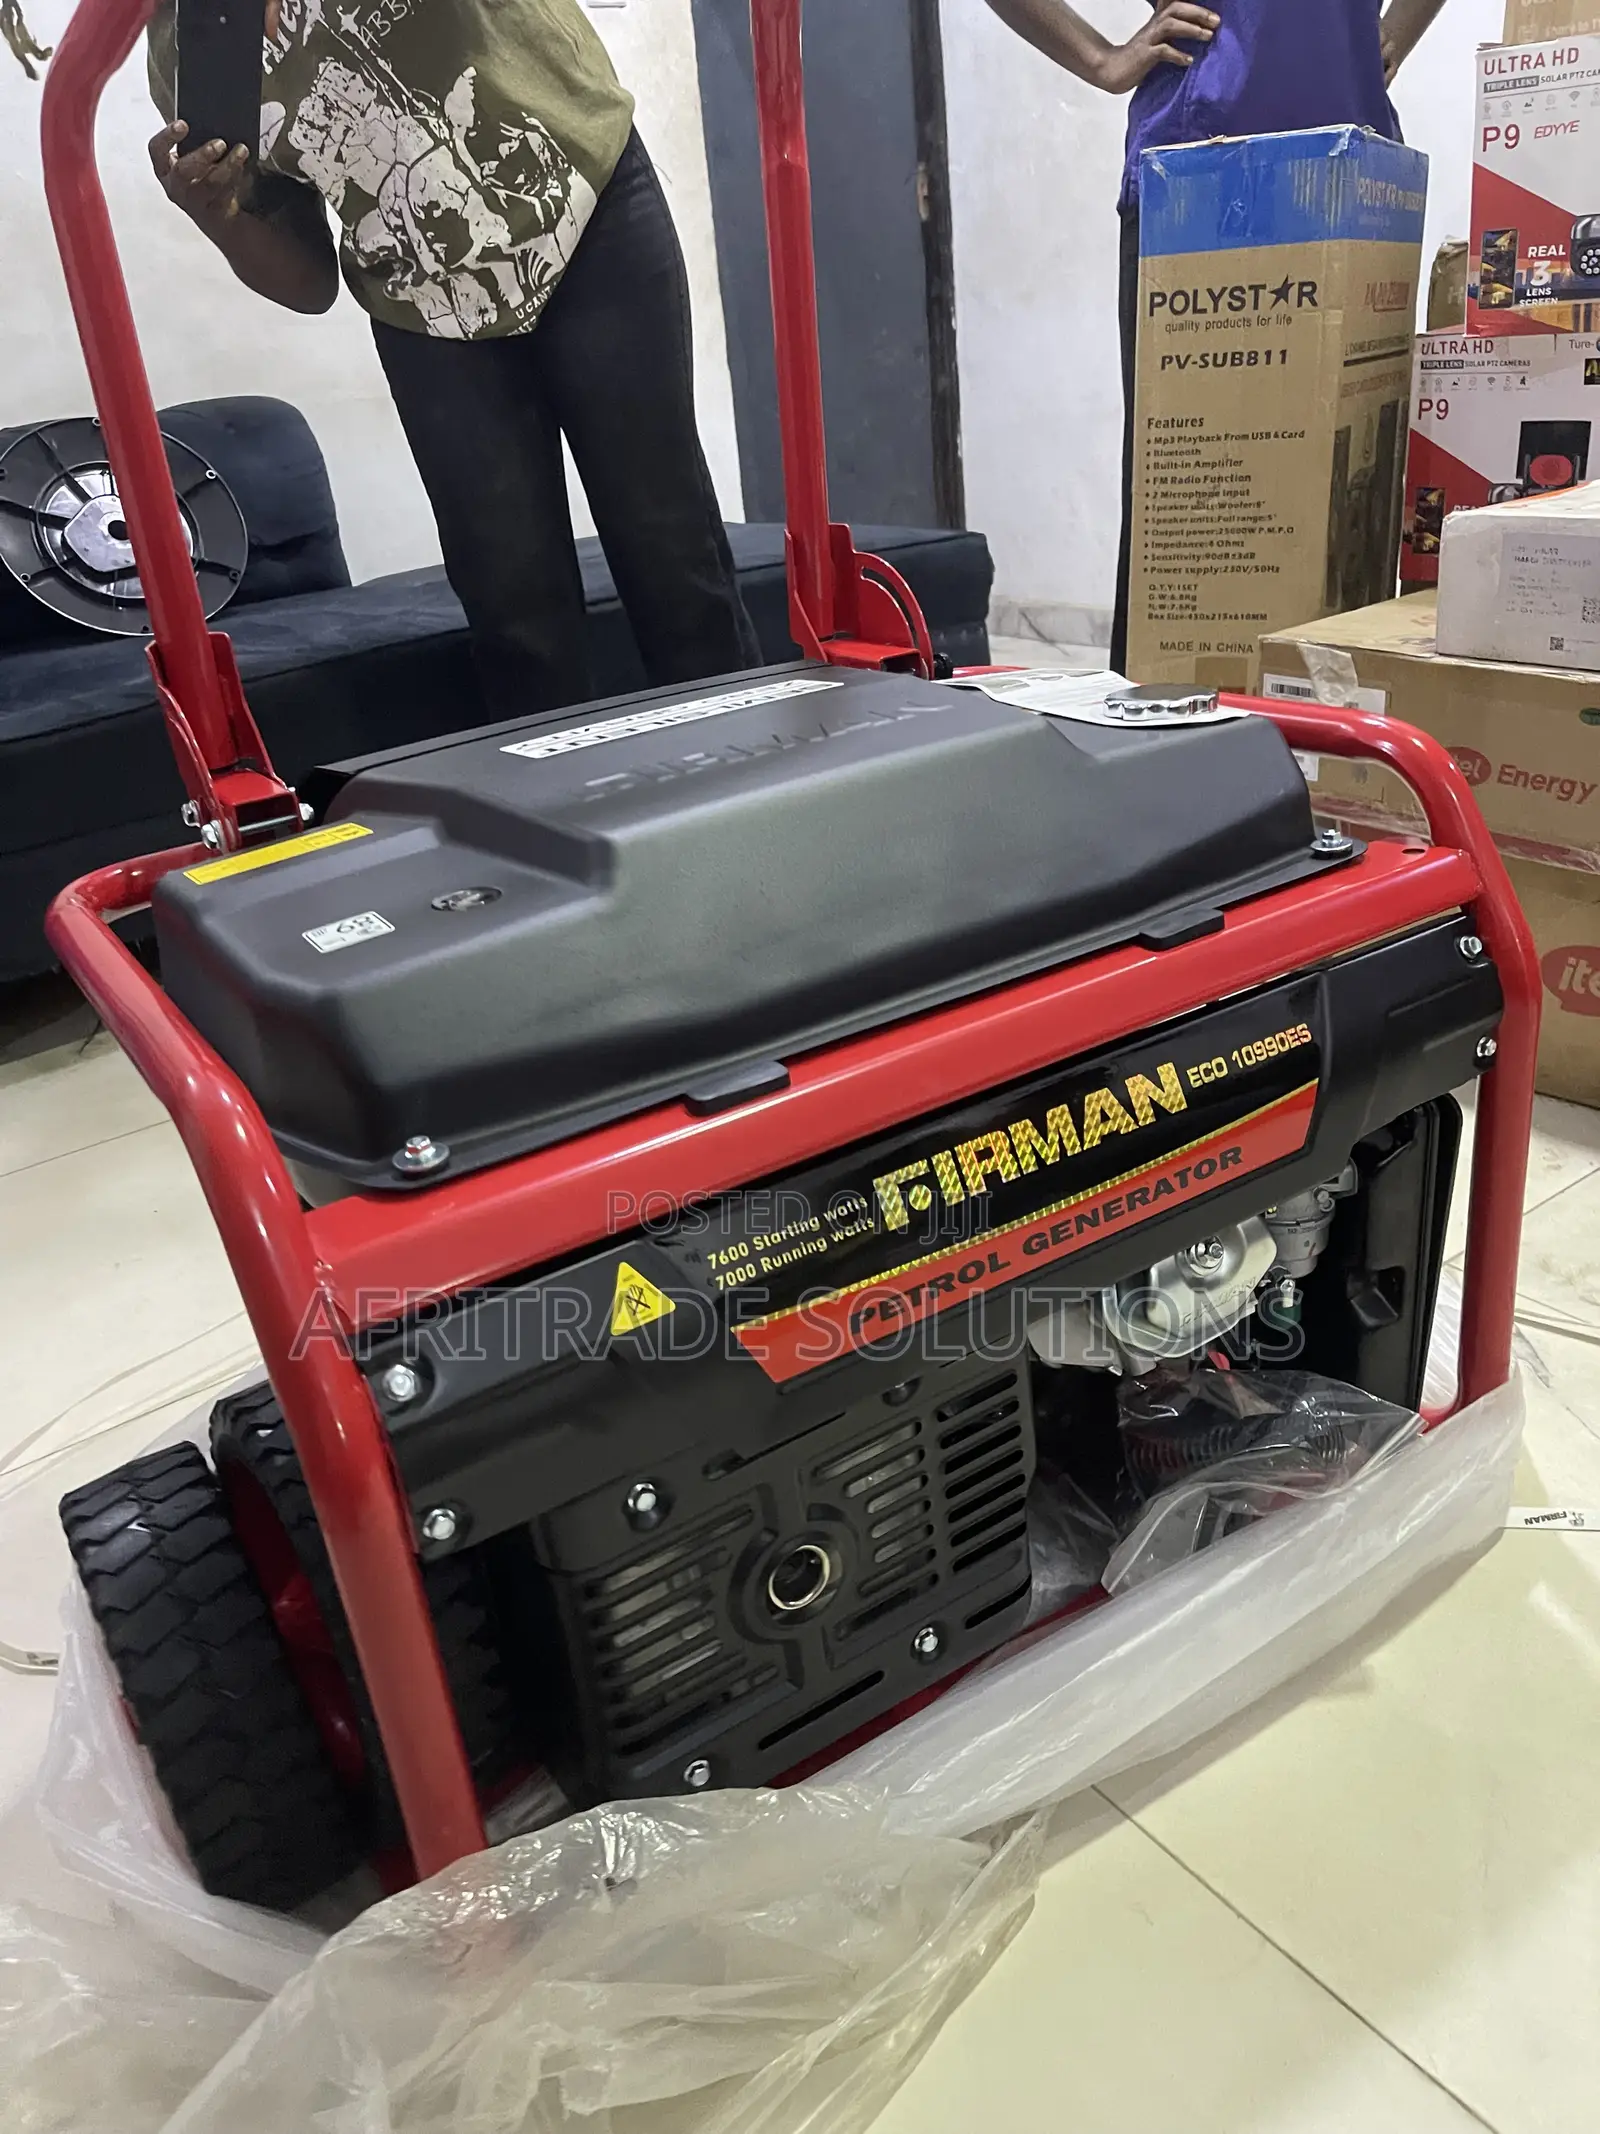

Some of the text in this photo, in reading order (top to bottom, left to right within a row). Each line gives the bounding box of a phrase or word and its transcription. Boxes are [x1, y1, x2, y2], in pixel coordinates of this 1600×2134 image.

[1484, 47, 1580, 75] ULTRA HD
[1486, 79, 1515, 92] TRIPLE
[1515, 77, 1537, 87] LENS
[1540, 73, 1567, 83] SOLAR
[1569, 70, 1585, 79] PTZ
[1482, 119, 1580, 152] P9 EDYYE
[1527, 244, 1566, 258] REAL
[1529, 260, 1553, 286] 3
[1526, 287, 1552, 296] LENS
[1165, 313, 1293, 334] quality products for life
[1421, 340, 1469, 355] ULTRA
[1473, 340, 1494, 354] HD
[1161, 349, 1288, 370] PV-SUB811
[1500, 359, 1531, 367] CAMERAS
[1418, 398, 1449, 421] P9
[1147, 416, 1205, 429] Features
[1154, 436, 1176, 446] Mp3
[1177, 433, 1222, 445] Playback
[1224, 432, 1250, 442] From
[1251, 431, 1272, 441] USB
[1281, 430, 1306, 440] Card
[1153, 448, 1202, 457] Bluetooth
[1153, 458, 1244, 470] Built-in Amplifier
[1152, 474, 1252, 485] FM Radio Function
[1160, 490, 1220, 501] Microphone
[1222, 488, 1251, 498] Input
[1150, 566, 1183, 574] Power
[1159, 641, 1254, 654] MADE IN CHINA
[1497, 763, 1598, 805] Energy
[873, 1023, 1313, 1230] FIRMAN ECO 10990ES
[706, 1194, 869, 1270] 7600 Starting watts
[851, 1145, 1243, 1335] PETROL GENERATOR
[715, 1216, 875, 1291] 7000 Running watts
[1524, 1510, 1568, 1525] FIRMAN
